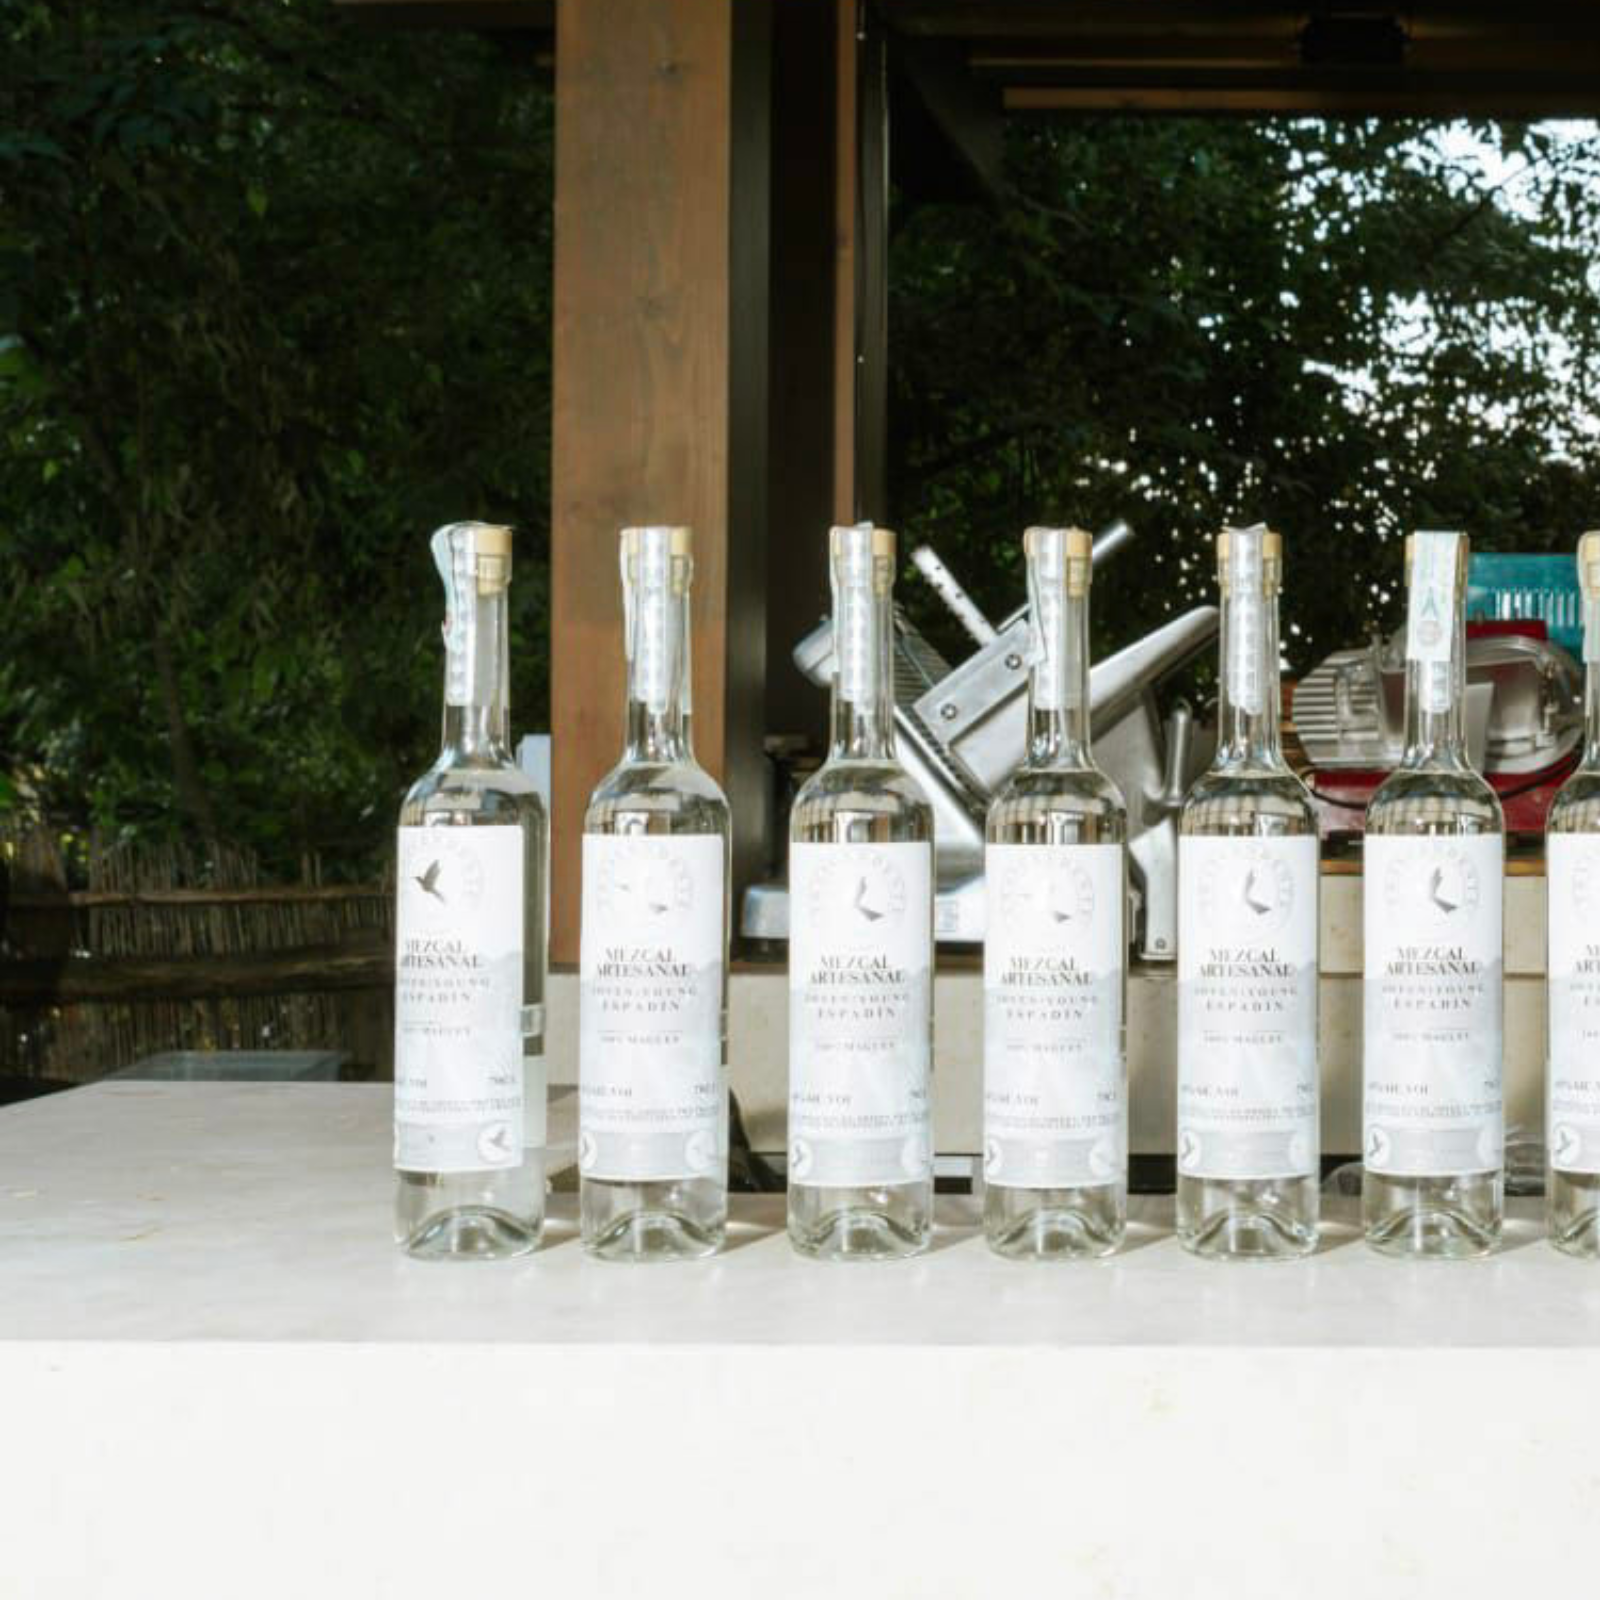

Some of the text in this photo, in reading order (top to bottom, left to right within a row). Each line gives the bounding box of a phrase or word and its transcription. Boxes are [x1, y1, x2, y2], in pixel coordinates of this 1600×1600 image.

[401, 954, 484, 969] TESANAL
[605, 947, 678, 963] MEZCAL
[820, 954, 889, 969] MEZCAL
[1209, 947, 1279, 963] MEZCAL
[1397, 946, 1467, 961] MEZCAL
[597, 962, 691, 978] ARTESANAL
[1010, 956, 1078, 971] MEZCAL
[1199, 962, 1294, 978] ARTESANAL
[1386, 961, 1481, 977] ARTESANAL
[810, 969, 905, 985] ARTESANAL
[1000, 971, 1093, 987] ARTESANAL
